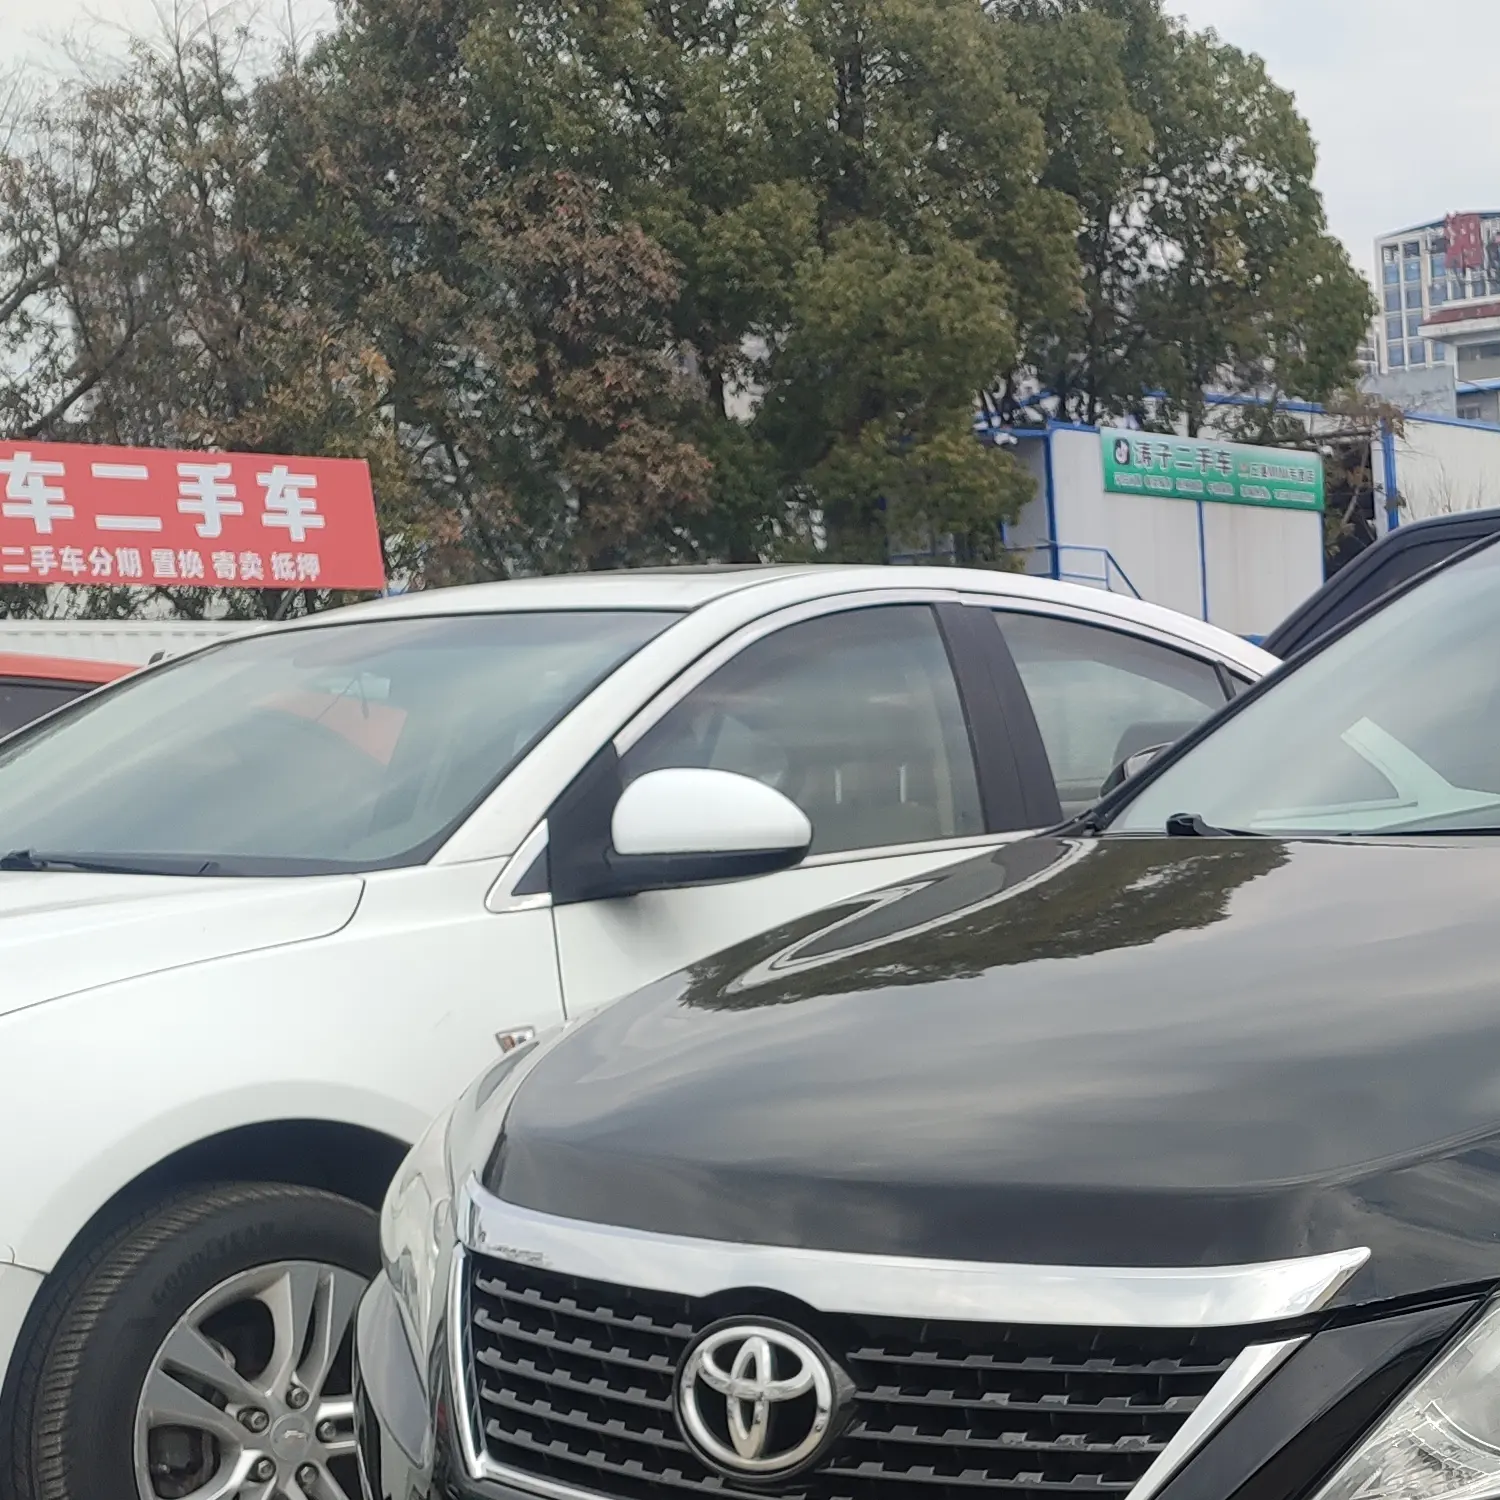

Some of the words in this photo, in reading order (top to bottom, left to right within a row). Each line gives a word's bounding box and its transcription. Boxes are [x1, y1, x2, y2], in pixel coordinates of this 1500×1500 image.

[0, 452, 326, 542] 车二手车
[1, 545, 143, 578] 二手车分期
[151, 548, 204, 579] 置换
[212, 551, 264, 581] 寄卖
[271, 552, 321, 582] 抵押
